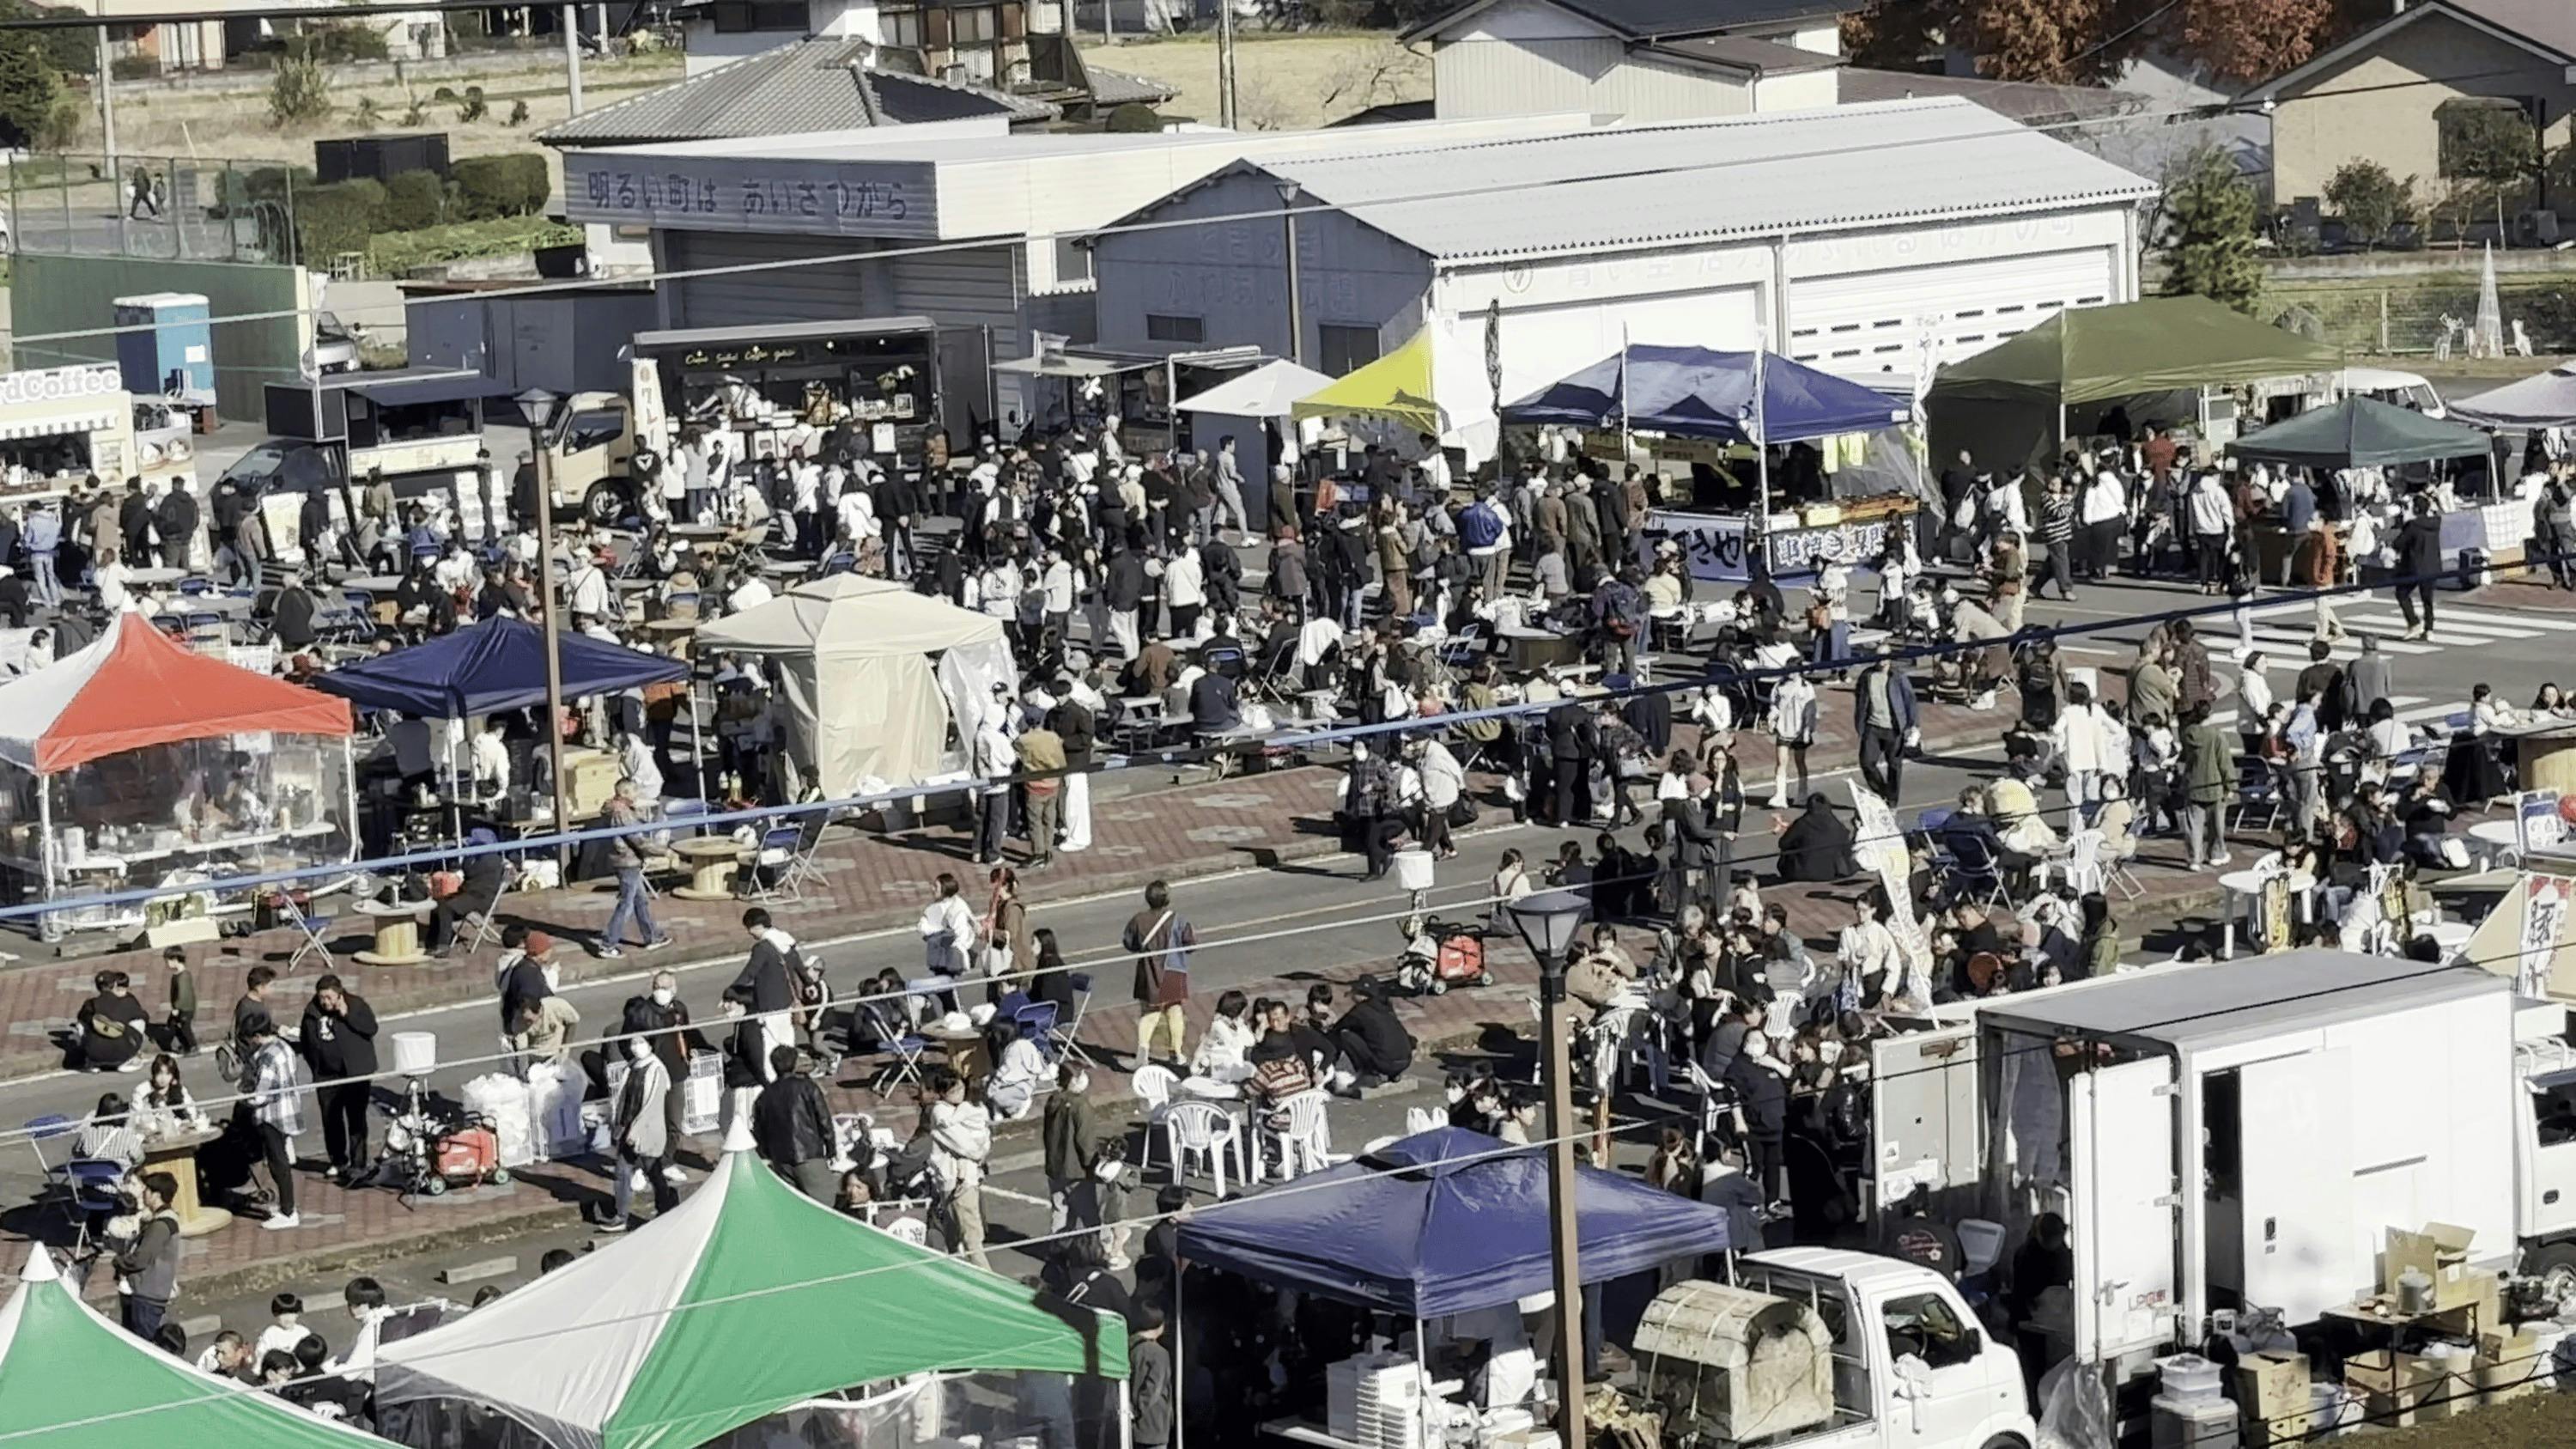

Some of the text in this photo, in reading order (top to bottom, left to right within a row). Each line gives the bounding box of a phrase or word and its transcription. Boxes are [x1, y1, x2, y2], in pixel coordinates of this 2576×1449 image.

[587, 171, 908, 221] 明るい町は あいさつから
[0, 369, 118, 401] dCoffee
